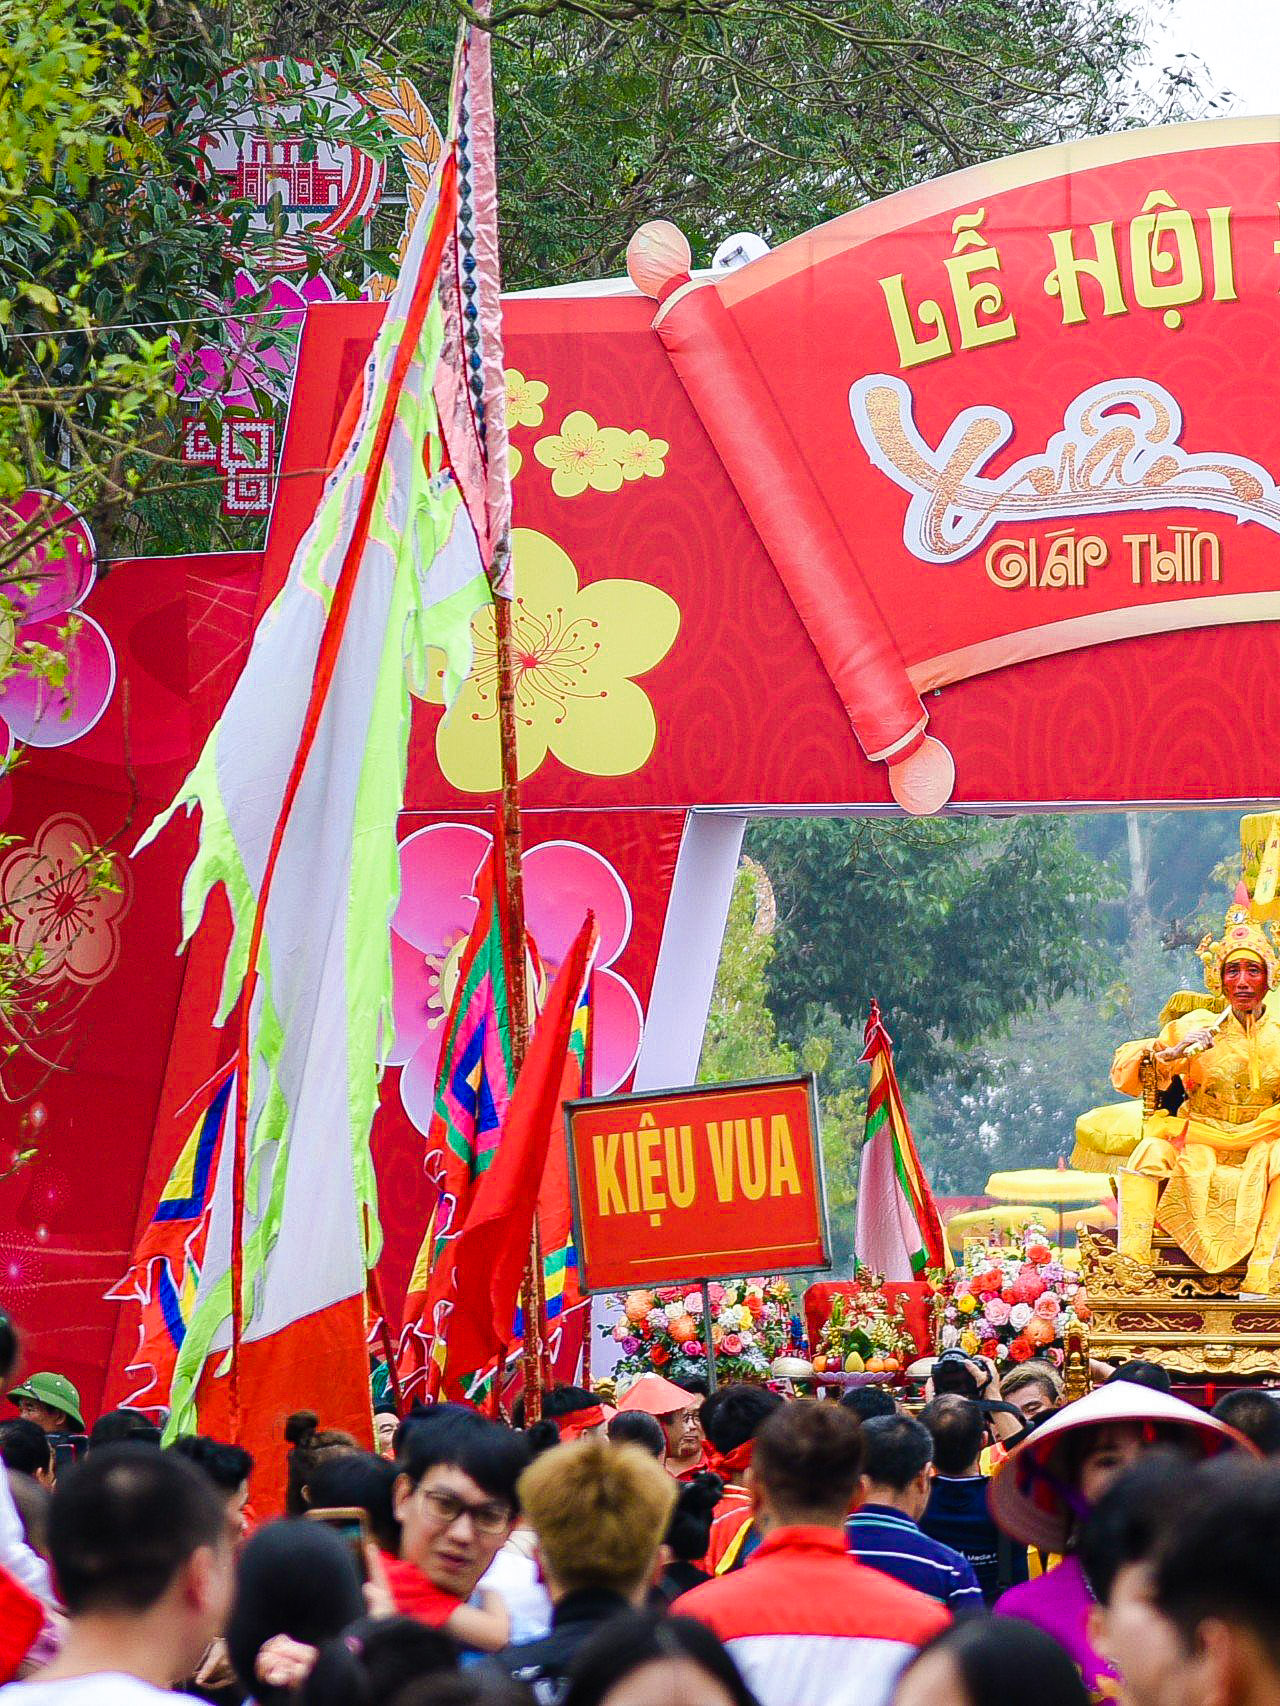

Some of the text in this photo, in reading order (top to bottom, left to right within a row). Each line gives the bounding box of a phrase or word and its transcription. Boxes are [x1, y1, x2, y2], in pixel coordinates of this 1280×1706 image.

[877, 207, 1017, 368] LỄ
[1044, 188, 1238, 329] HỘI
[985, 527, 1109, 588] GIÁP
[592, 1112, 802, 1227] KIỆU VUA
